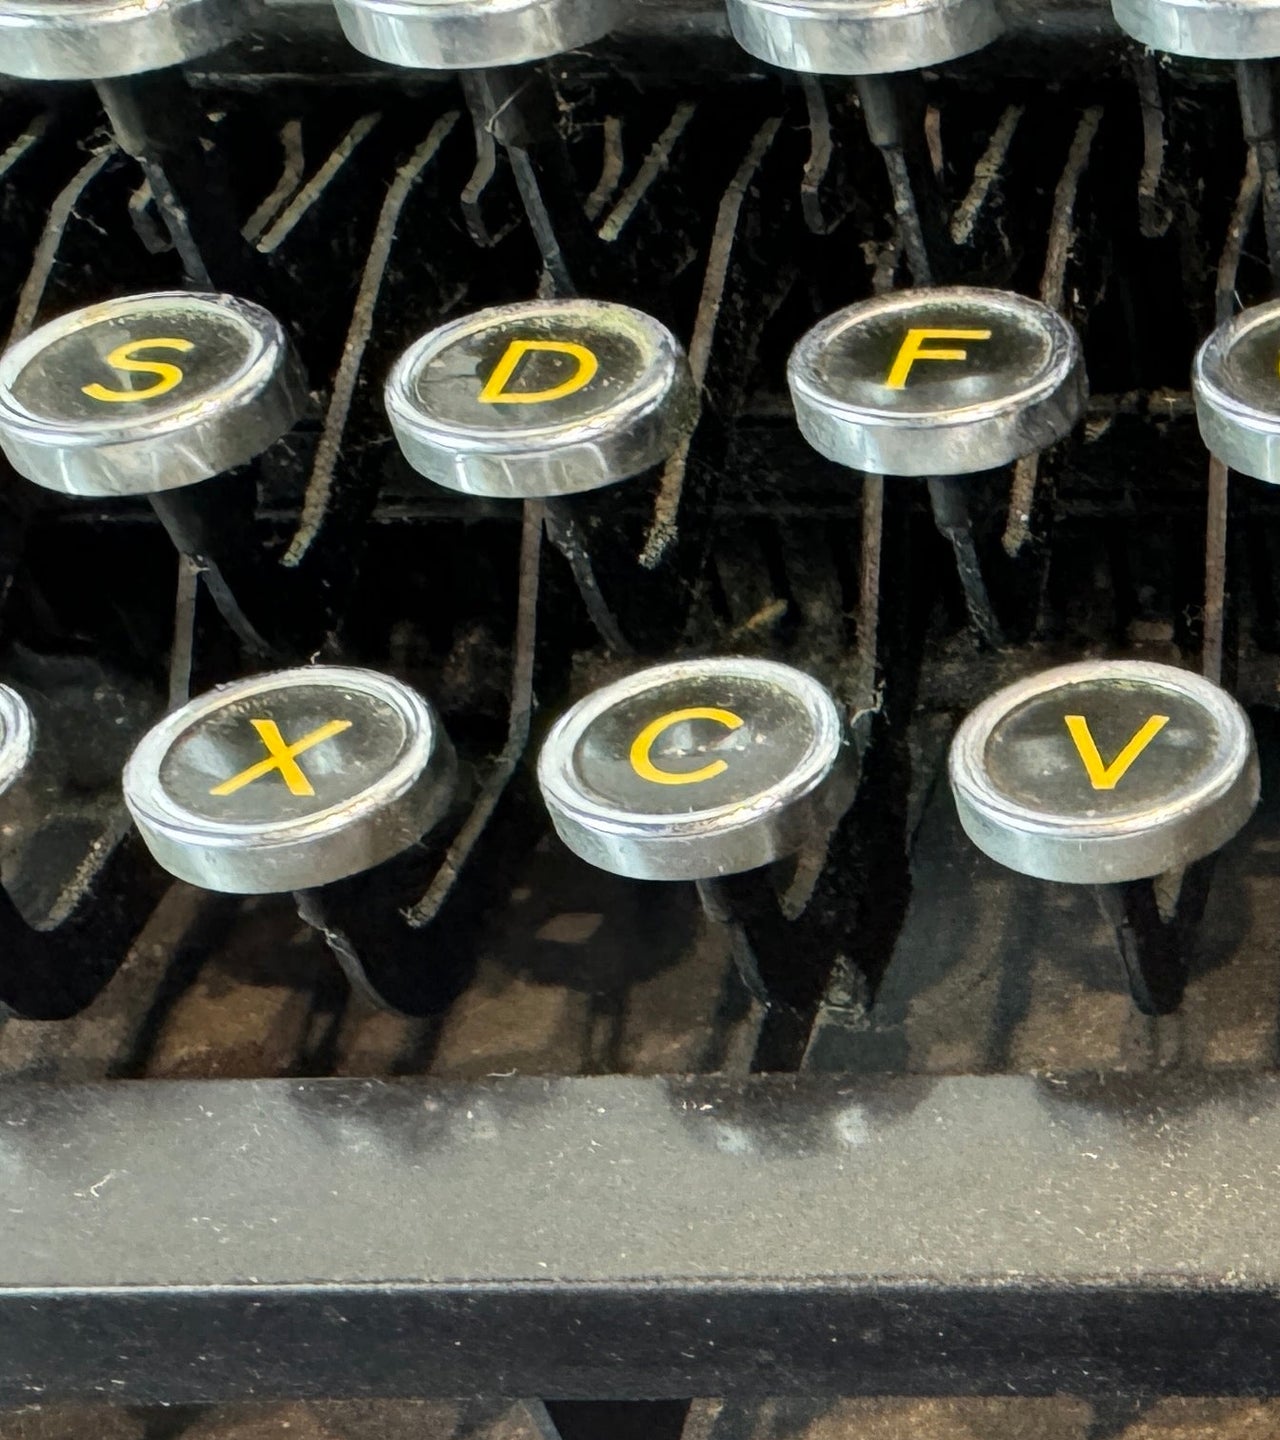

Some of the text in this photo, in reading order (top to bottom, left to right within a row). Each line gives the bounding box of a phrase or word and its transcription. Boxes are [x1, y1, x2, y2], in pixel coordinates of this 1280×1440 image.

[80, 337, 195, 403] S
[478, 338, 600, 405] D
[884, 326, 992, 392] F
[208, 717, 354, 797] X
[628, 705, 744, 786] C
[1062, 712, 1170, 791] V
